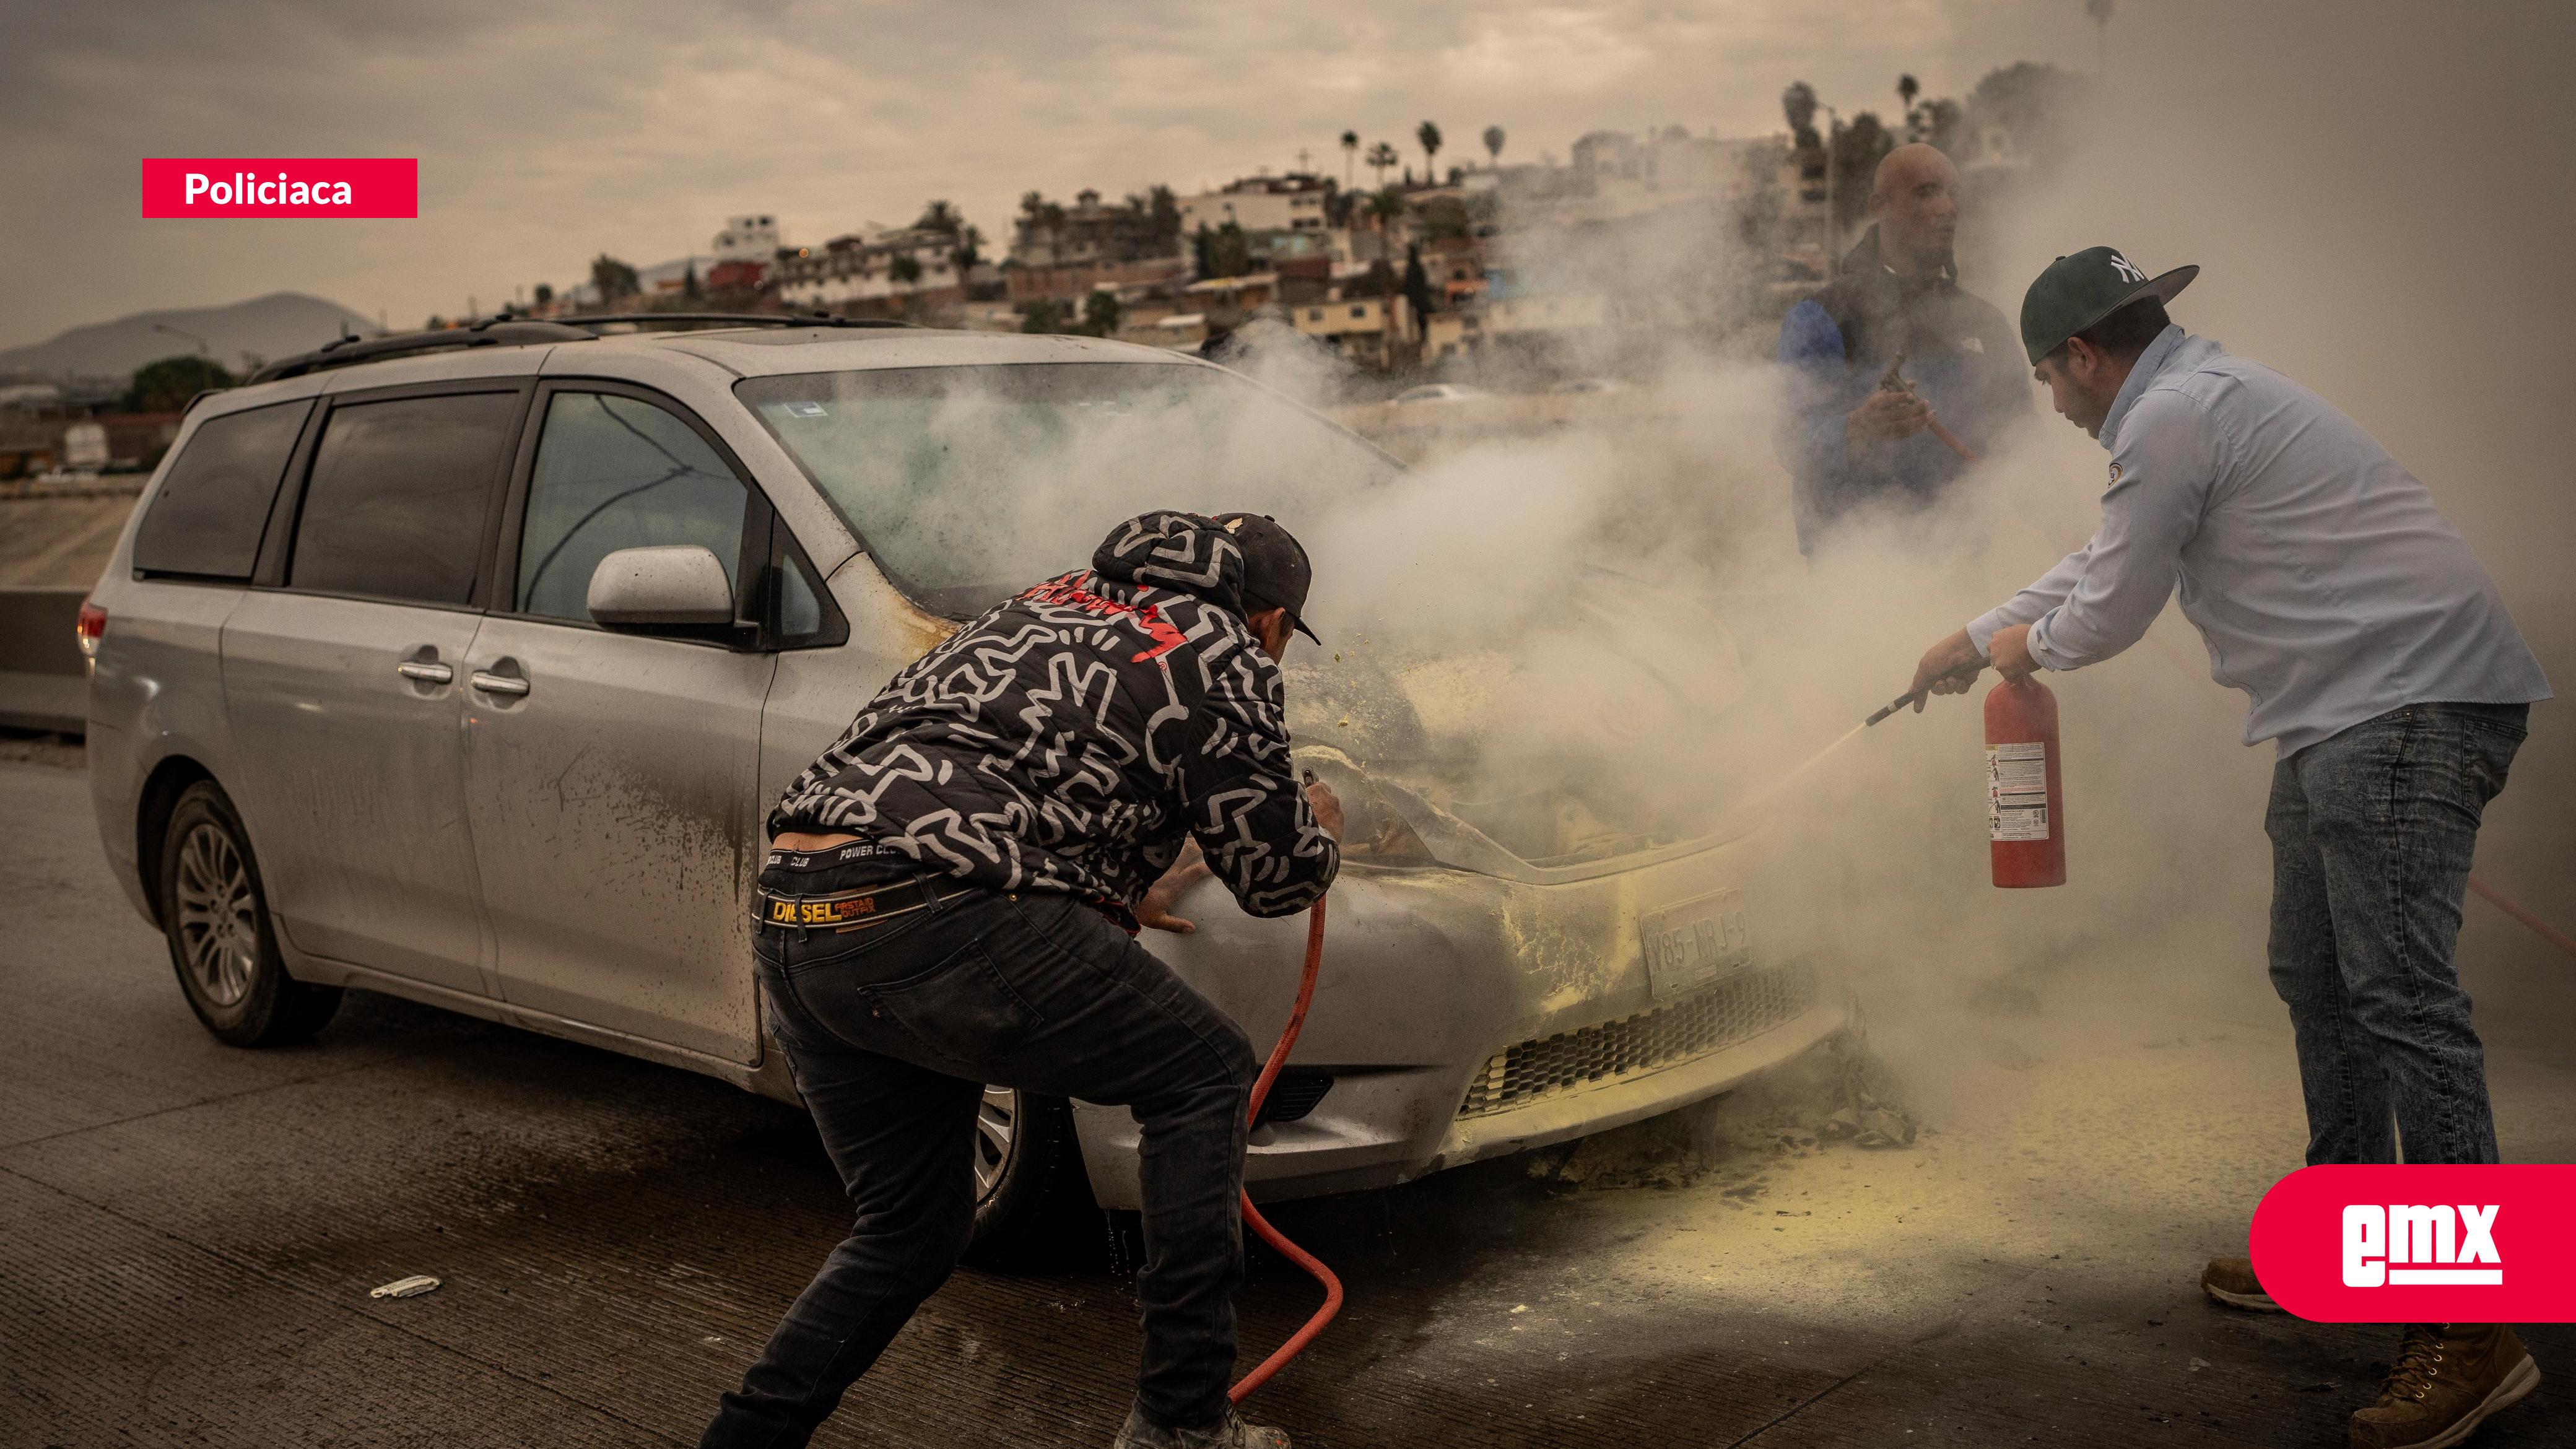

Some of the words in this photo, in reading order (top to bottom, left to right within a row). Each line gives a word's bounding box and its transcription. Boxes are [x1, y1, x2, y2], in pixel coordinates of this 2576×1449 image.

[839, 845, 874, 861] POWER
[876, 845, 900, 855] CLU
[791, 856, 810, 867] CLUB
[773, 902, 843, 923] DIESEL
